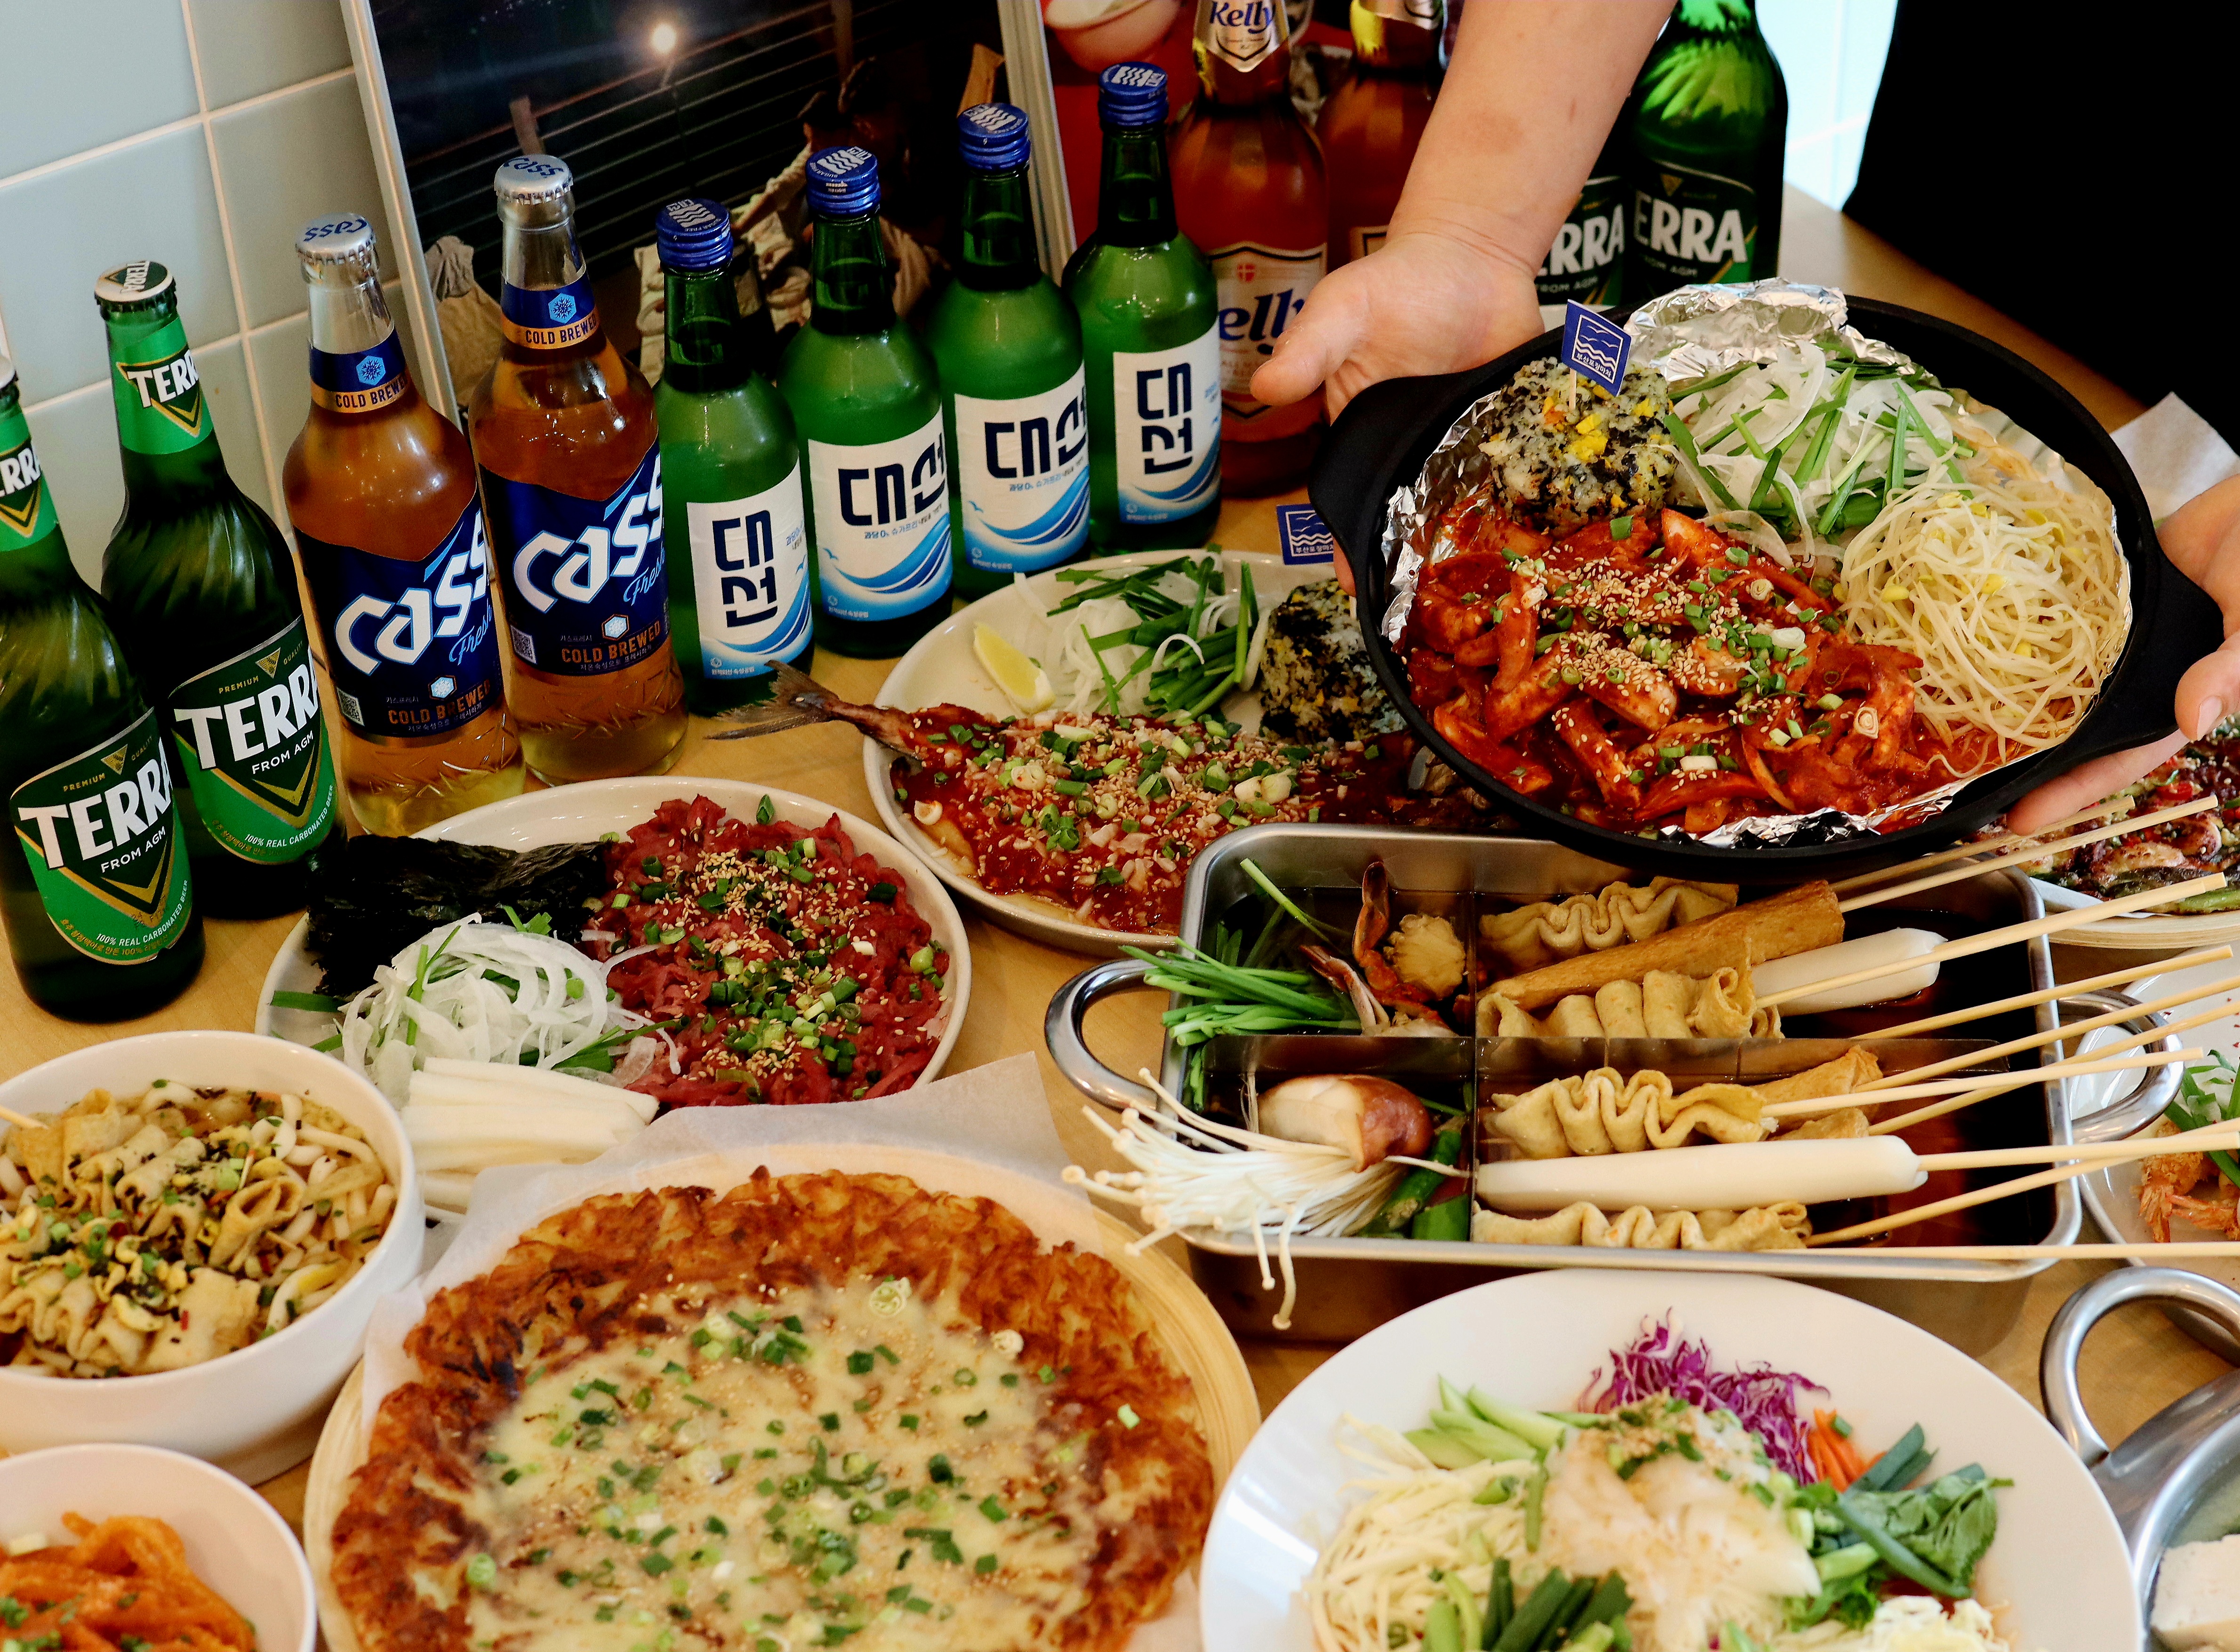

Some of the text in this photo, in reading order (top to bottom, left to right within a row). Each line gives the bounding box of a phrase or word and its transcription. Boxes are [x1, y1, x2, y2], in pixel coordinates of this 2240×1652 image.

[1210, 0, 1276, 34] Kelly
[1537, 203, 1625, 276] RRA
[1633, 189, 1748, 263] ERRA
[120, 261, 150, 294] TERRA
[526, 313, 597, 344] COLD BREWED
[1218, 289, 1307, 356] ell
[127, 349, 199, 408] TERR
[1576, 352, 1612, 378] 부산포장마차
[335, 374, 406, 408] COLD BREWE
[449, 598, 492, 666] Fresh
[561, 620, 661, 663] COLD BREWED
[219, 640, 303, 694] PREMIUM QUALITY
[388, 679, 490, 725] COLD BREWED
[252, 730, 314, 775] FROM AGM
[63, 773, 106, 792] PREMIUM
[245, 833, 264, 846] 100%
[266, 839, 288, 848] REAL
[289, 807, 328, 845] CARBONATED
[100, 826, 166, 874] FROM AGM
[96, 933, 116, 946] 100%
[119, 936, 141, 947] REAL
[143, 903, 183, 944] CARBONATED
